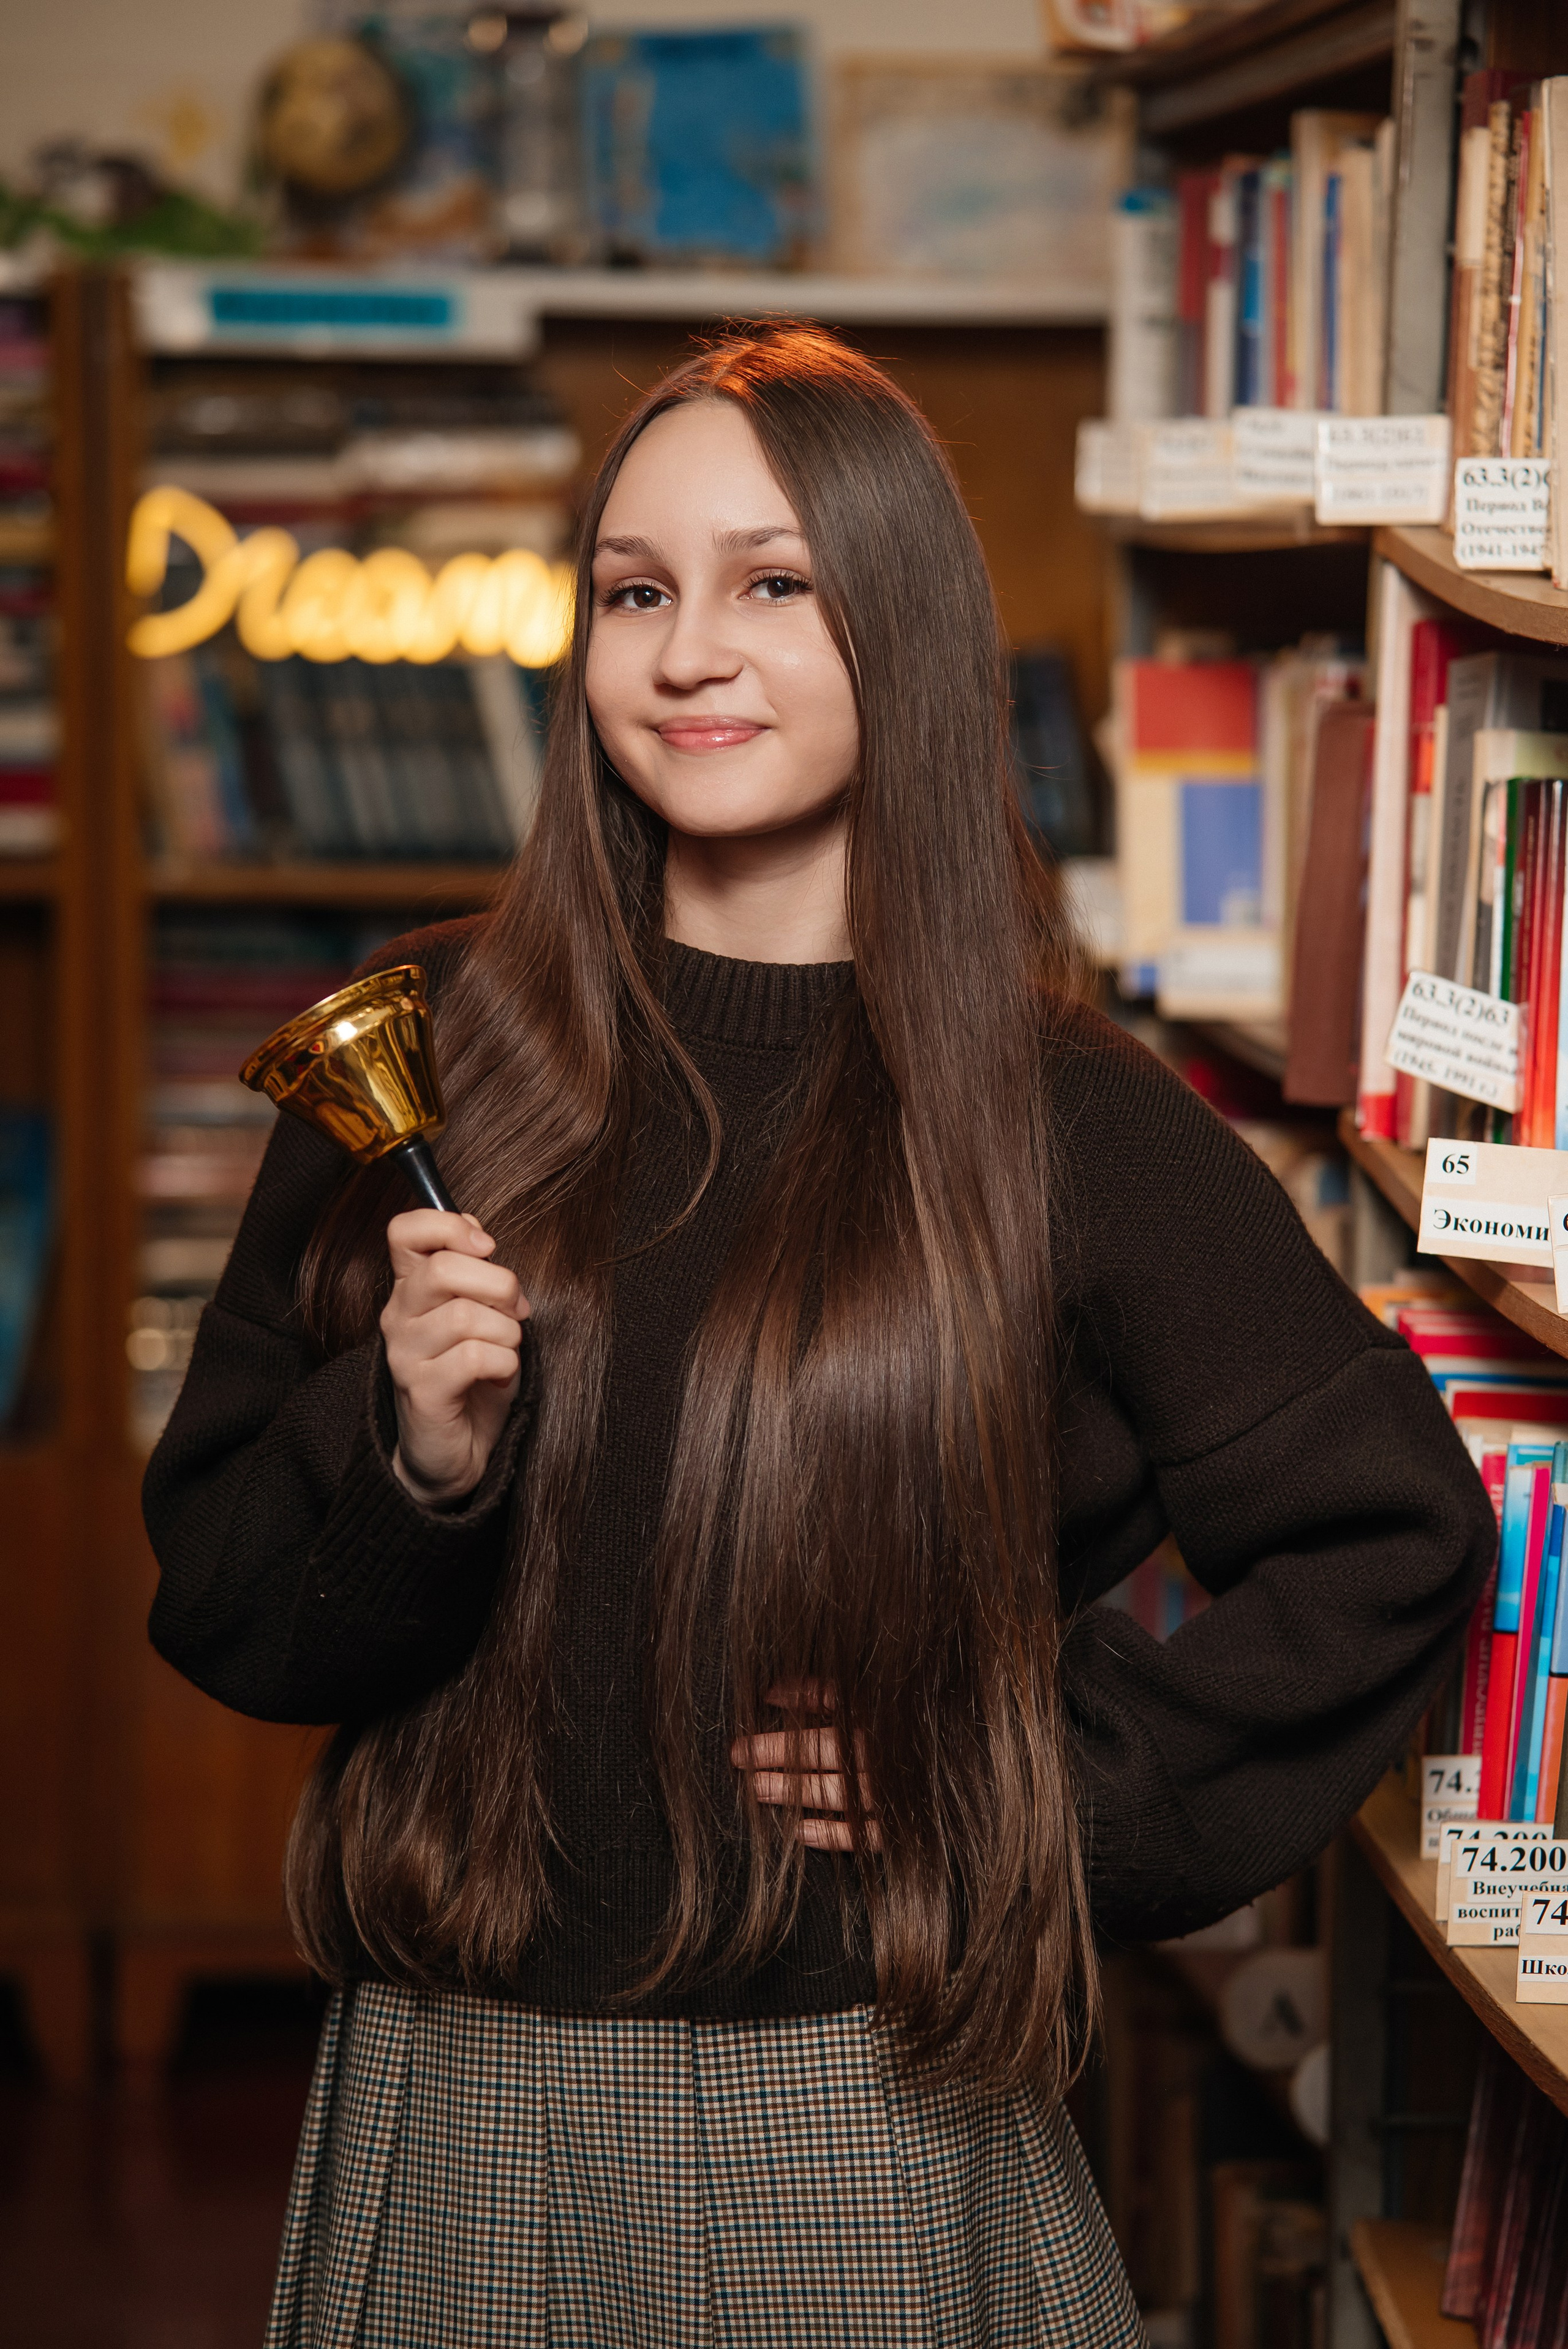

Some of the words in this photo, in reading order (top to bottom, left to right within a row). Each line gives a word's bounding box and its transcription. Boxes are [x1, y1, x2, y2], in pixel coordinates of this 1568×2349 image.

[1460, 543, 1544, 560] (1941-194
[1442, 1153, 1470, 1174] 65
[1433, 1208, 1550, 1242] Экономи
[1429, 1768, 1480, 1793] 74.
[1461, 1846, 1567, 1872] 74.200
[1457, 1908, 1521, 1919] воспит
[1532, 1899, 1568, 1926] 74
[1521, 1959, 1568, 1975] Шко
